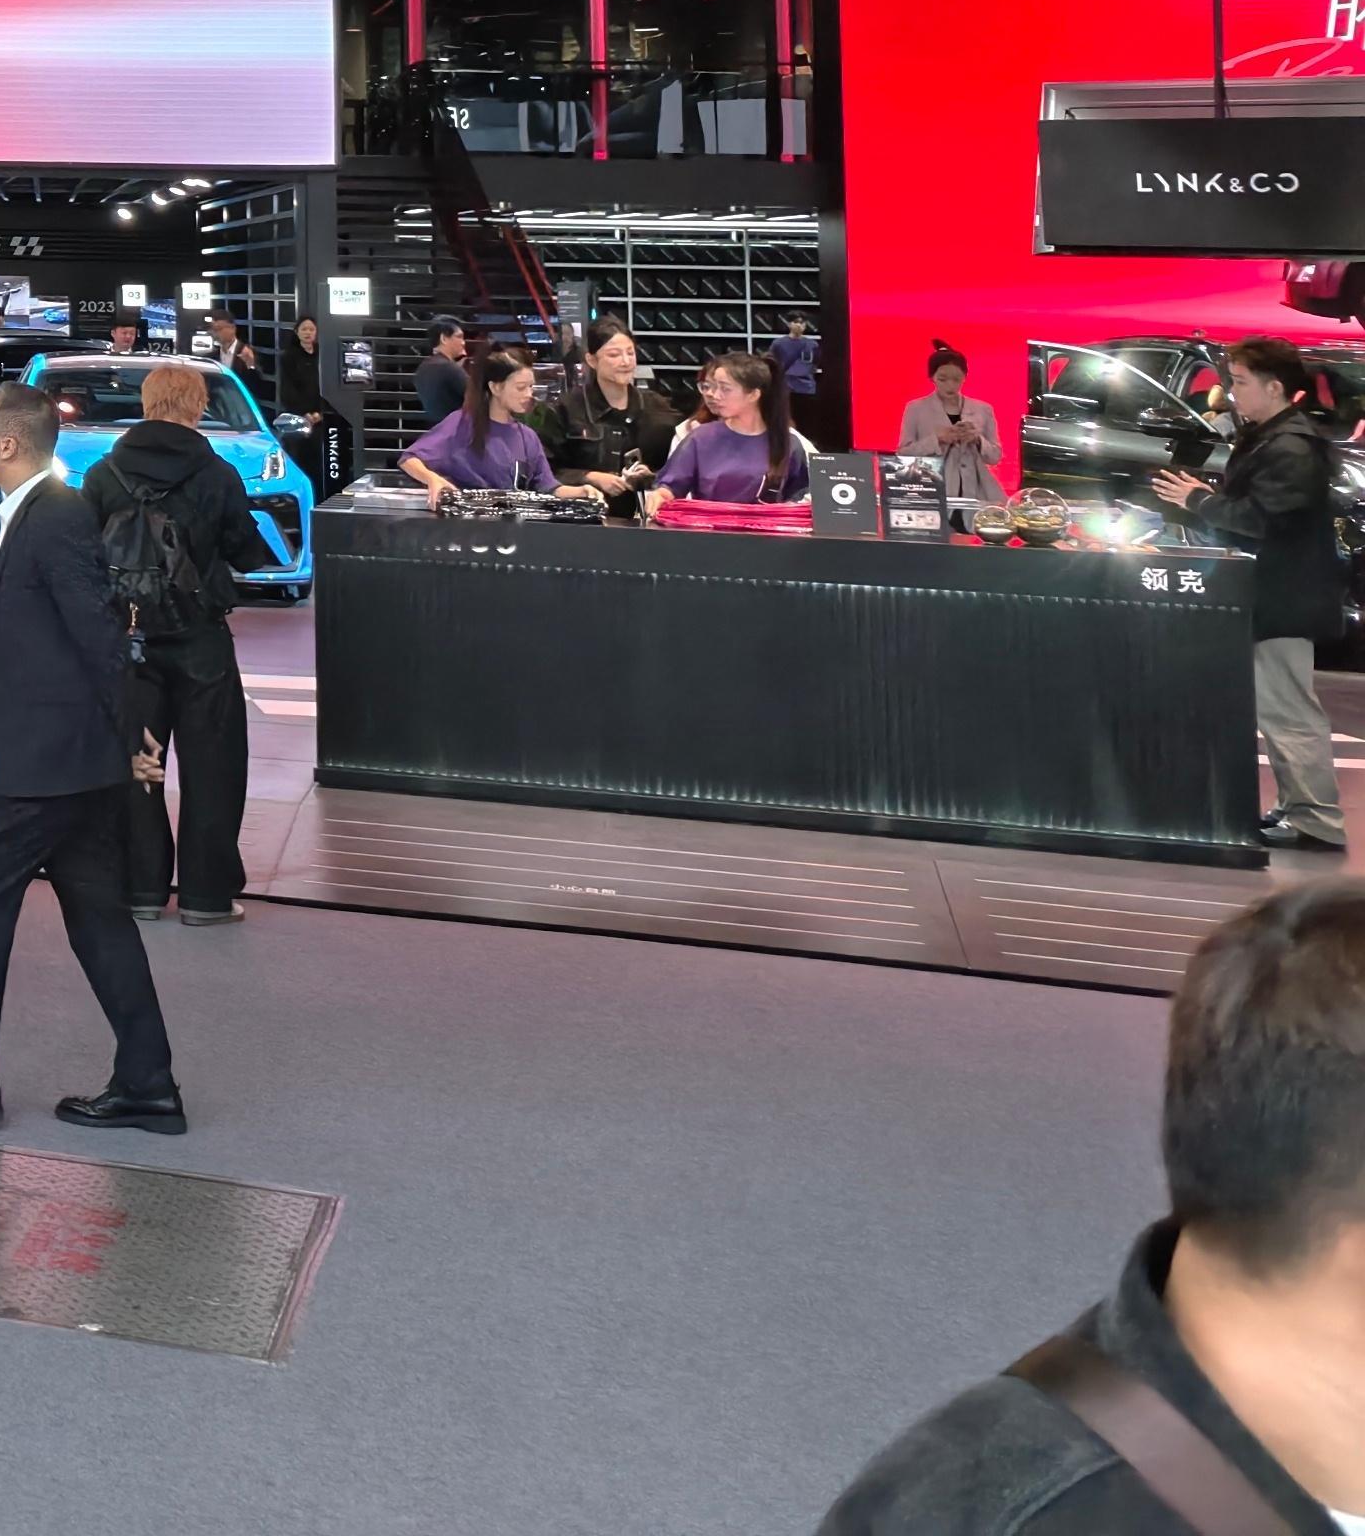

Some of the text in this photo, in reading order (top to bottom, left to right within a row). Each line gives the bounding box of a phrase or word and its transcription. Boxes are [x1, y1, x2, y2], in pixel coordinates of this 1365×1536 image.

[1136, 172, 1300, 193] LYNK&CO
[78, 300, 116, 313] 2023
[1140, 566, 1206, 594] 领克
